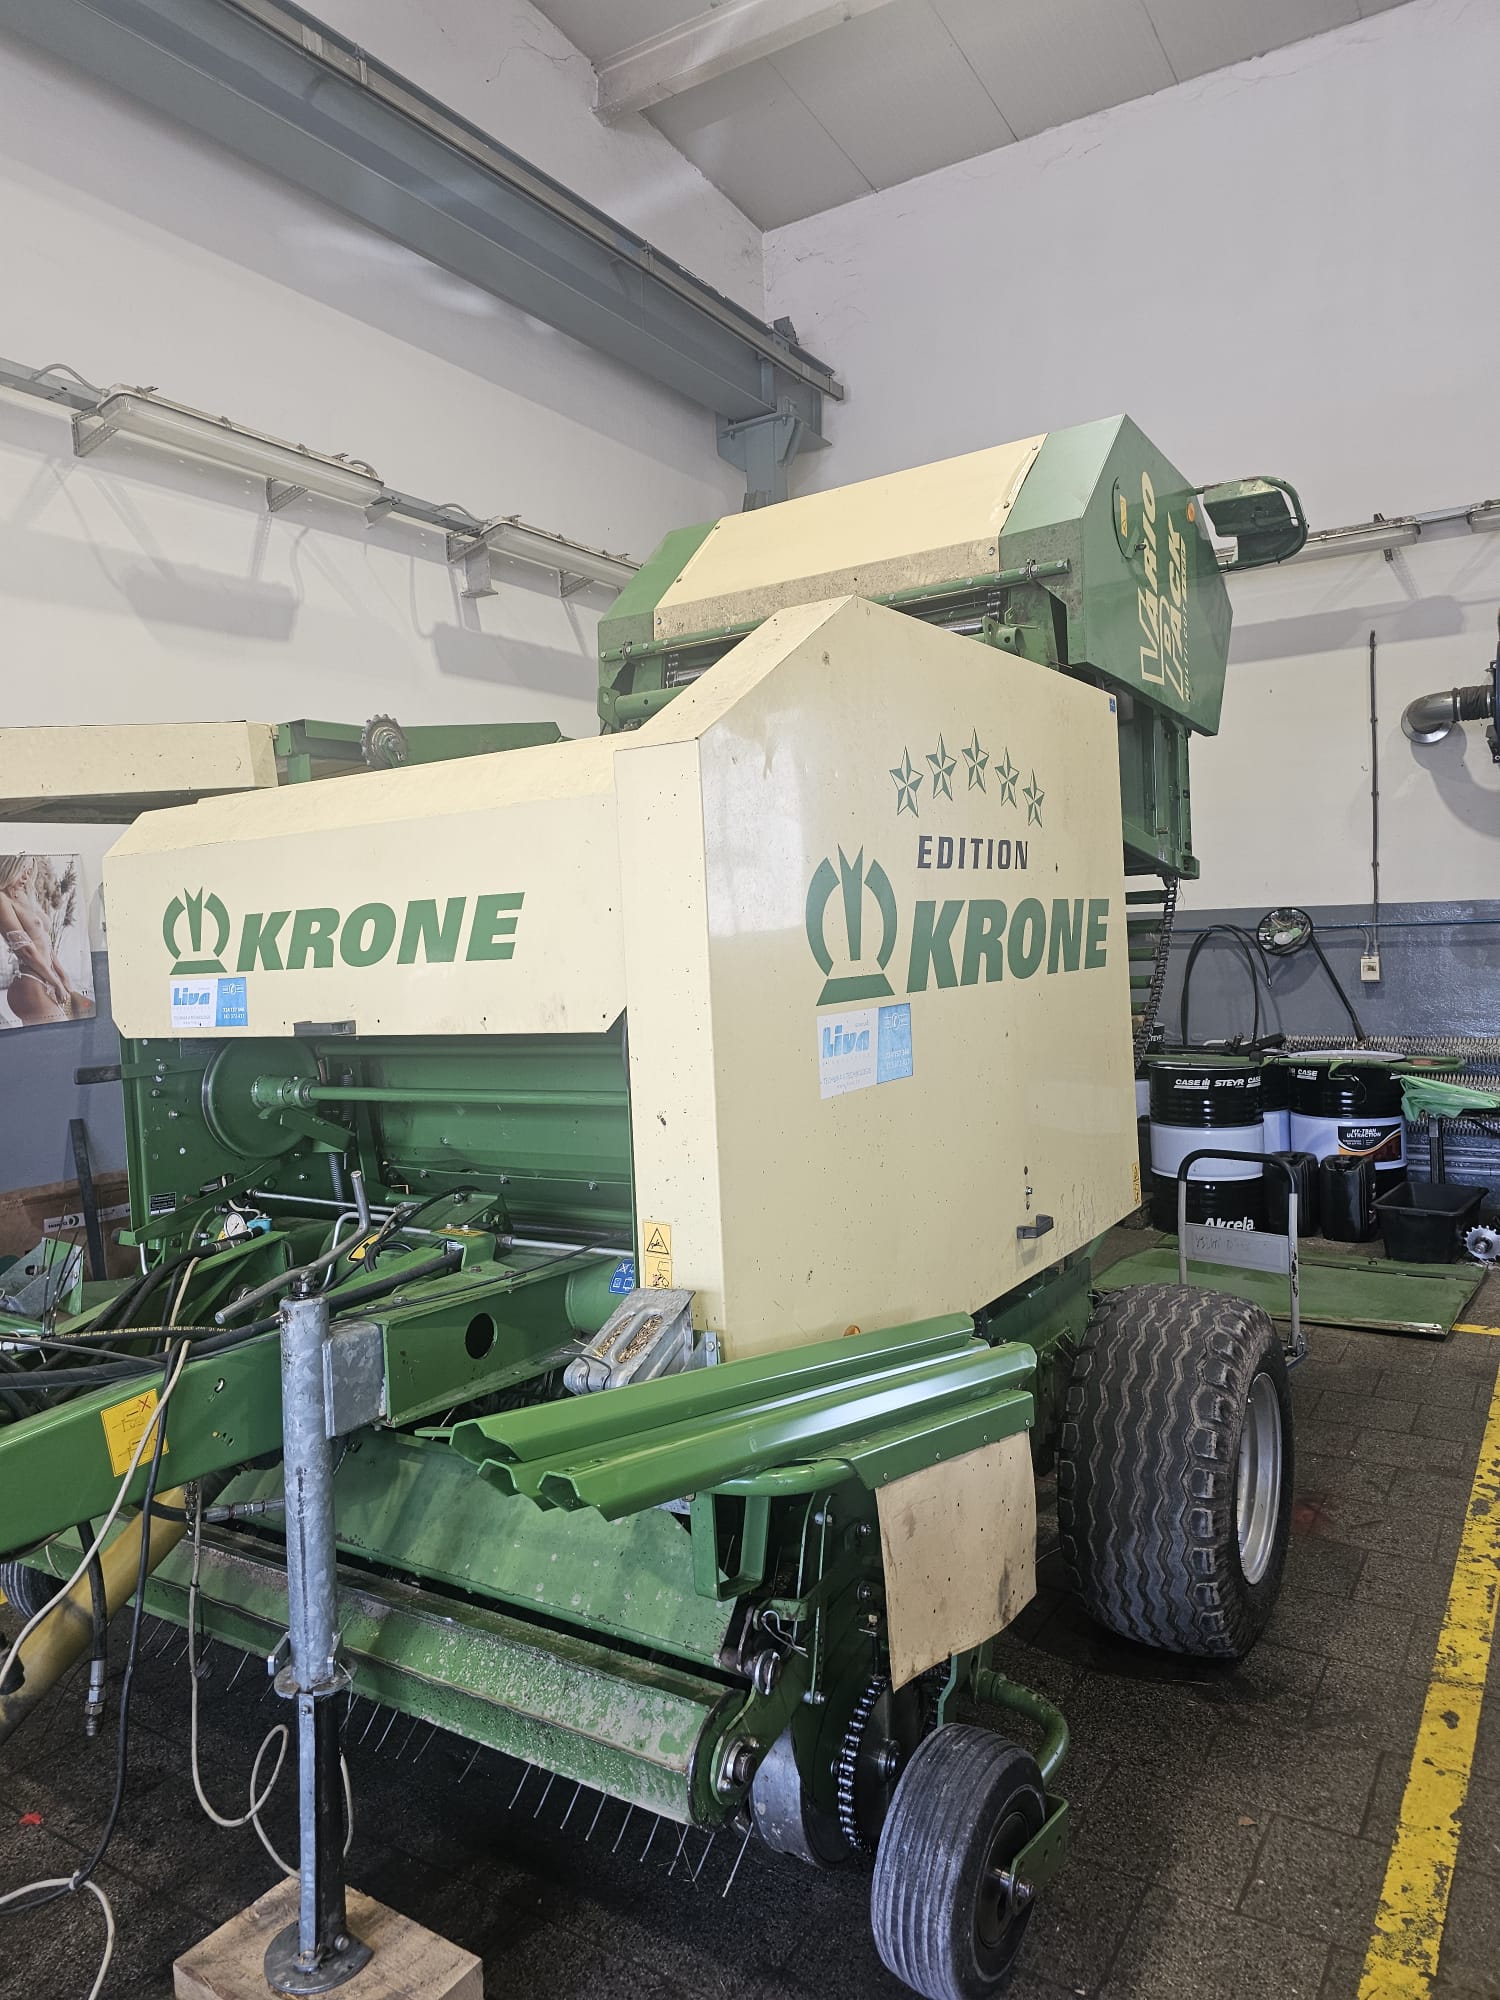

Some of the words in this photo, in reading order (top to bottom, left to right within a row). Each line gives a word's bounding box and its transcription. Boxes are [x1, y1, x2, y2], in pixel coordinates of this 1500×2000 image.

[917, 835, 1029, 870] EDITION
[236, 891, 525, 972] KRONE
[906, 898, 1110, 993] KRONE
[1214, 1079, 1245, 1087] STEYR
[1296, 1069, 1318, 1077] CASE
[1204, 1216, 1256, 1232] Akcela
